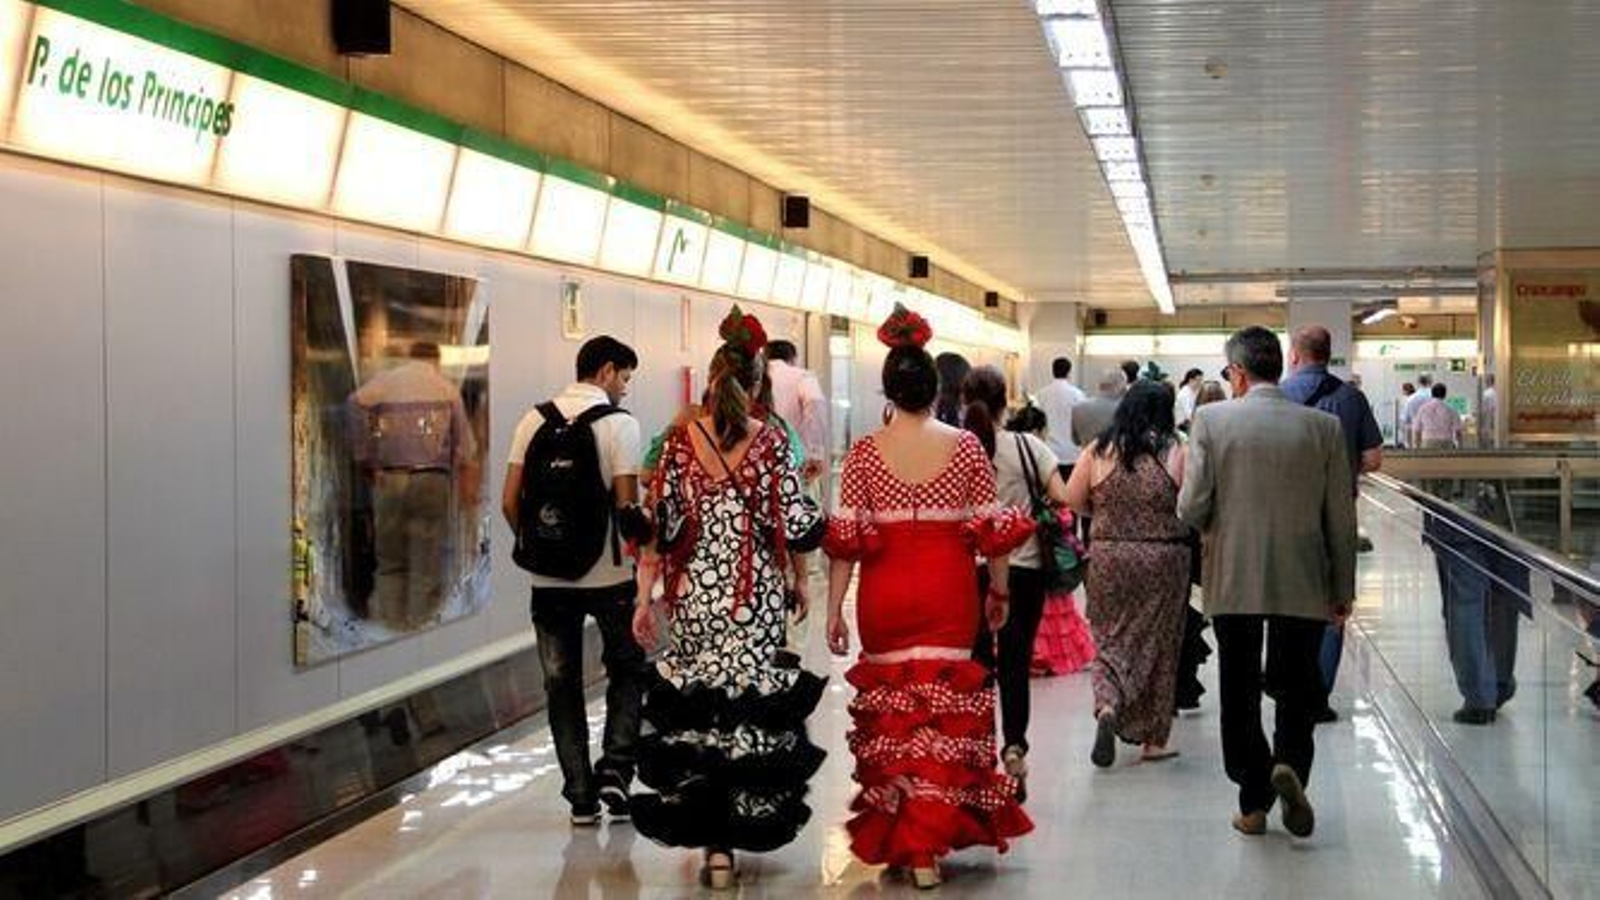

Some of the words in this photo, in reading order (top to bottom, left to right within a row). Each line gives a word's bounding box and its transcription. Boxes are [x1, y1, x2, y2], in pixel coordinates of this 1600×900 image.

[28, 35, 50, 87] P.
[58, 48, 92, 98] de
[98, 57, 134, 109] los
